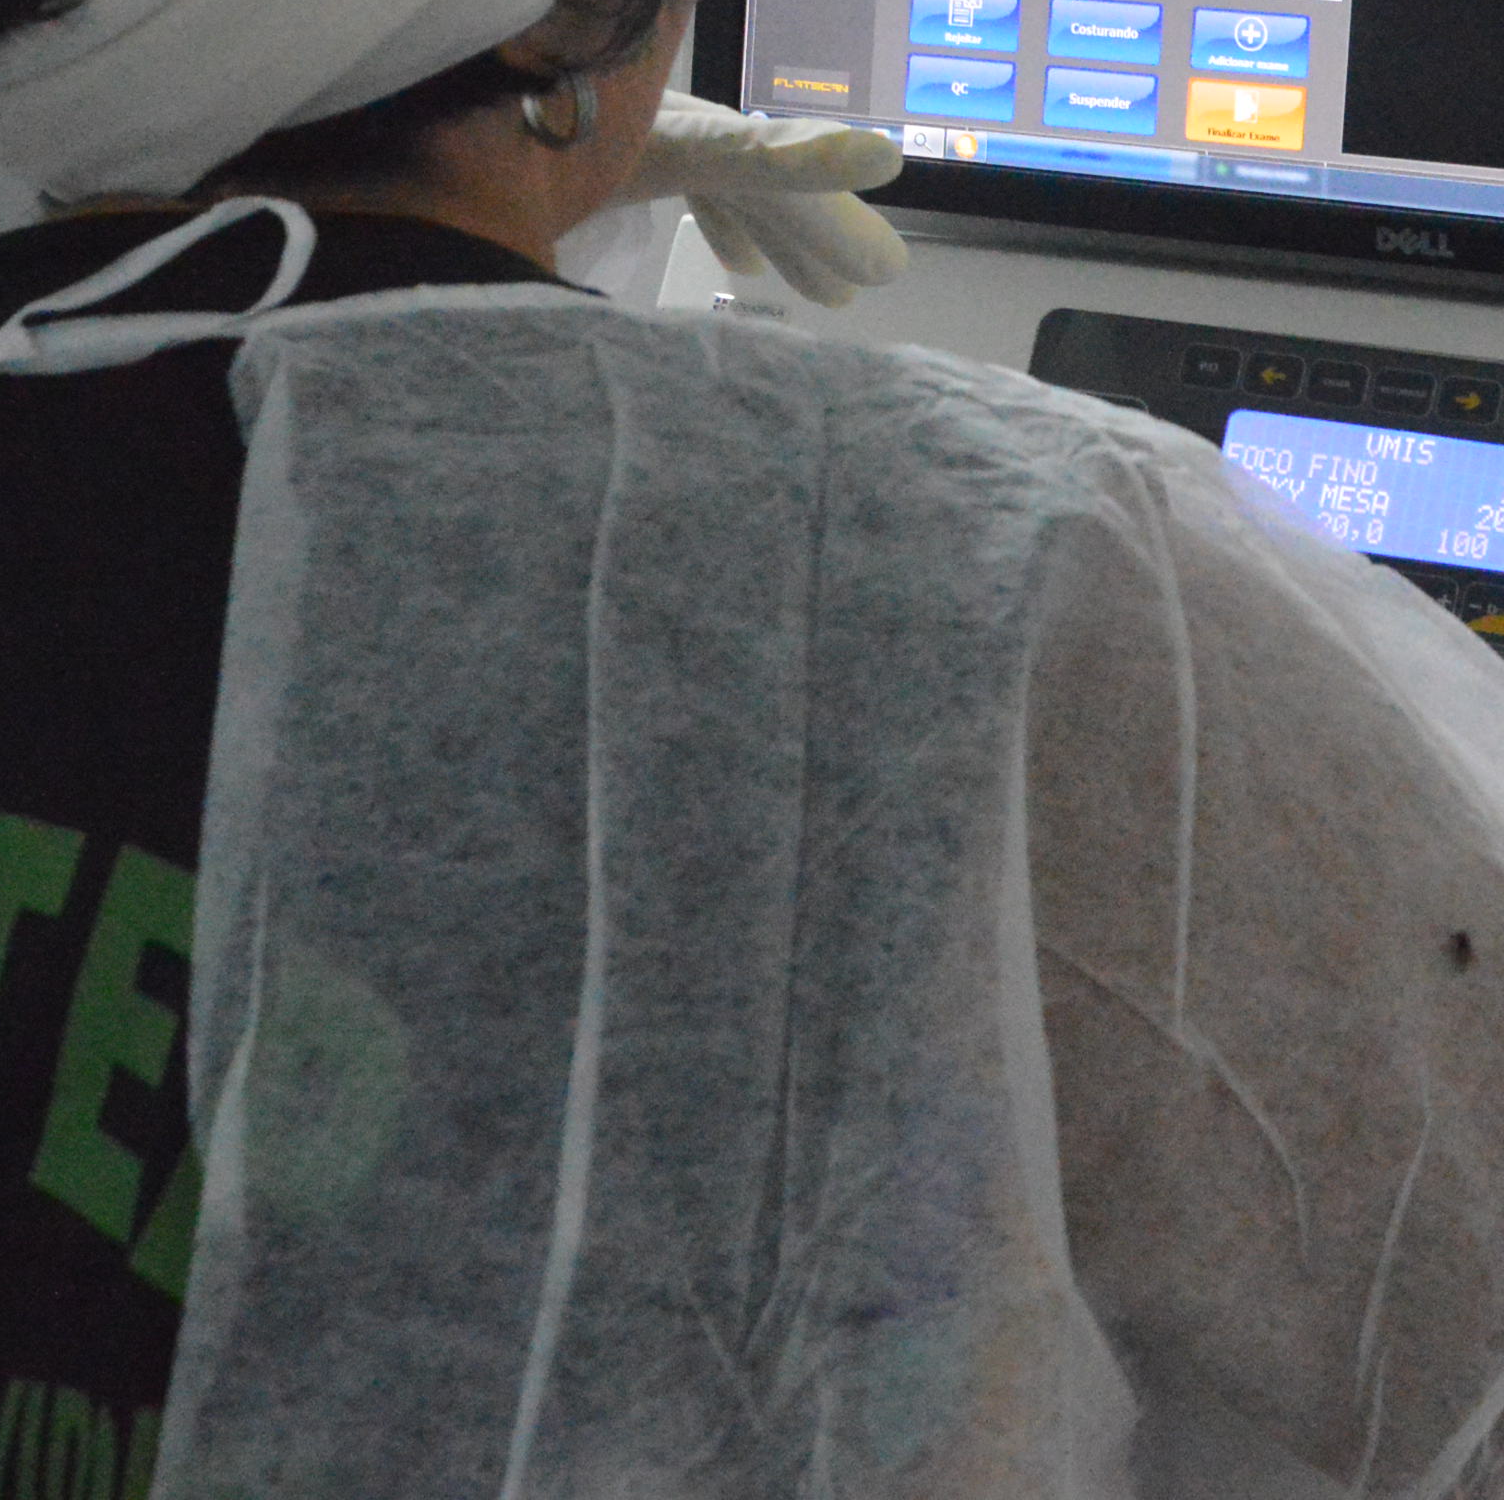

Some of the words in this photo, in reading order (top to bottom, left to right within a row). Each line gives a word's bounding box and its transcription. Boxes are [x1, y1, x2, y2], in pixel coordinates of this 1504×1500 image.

[1071, 22, 1139, 40] Costurando
[1208, 55, 1254, 70] Adicionar
[951, 81, 969, 96] QC
[1069, 92, 1132, 110] Suspender
[1207, 126, 1246, 140] Finalizar
[1249, 131, 1281, 143] Exame
[1376, 226, 1455, 258] DELL
[1366, 433, 1436, 465] VMIS
[1227, 443, 1293, 474] FOCO
[1308, 453, 1378, 486] FINO
[1319, 483, 1391, 517] MESA
[1436, 529, 1489, 560] 100
